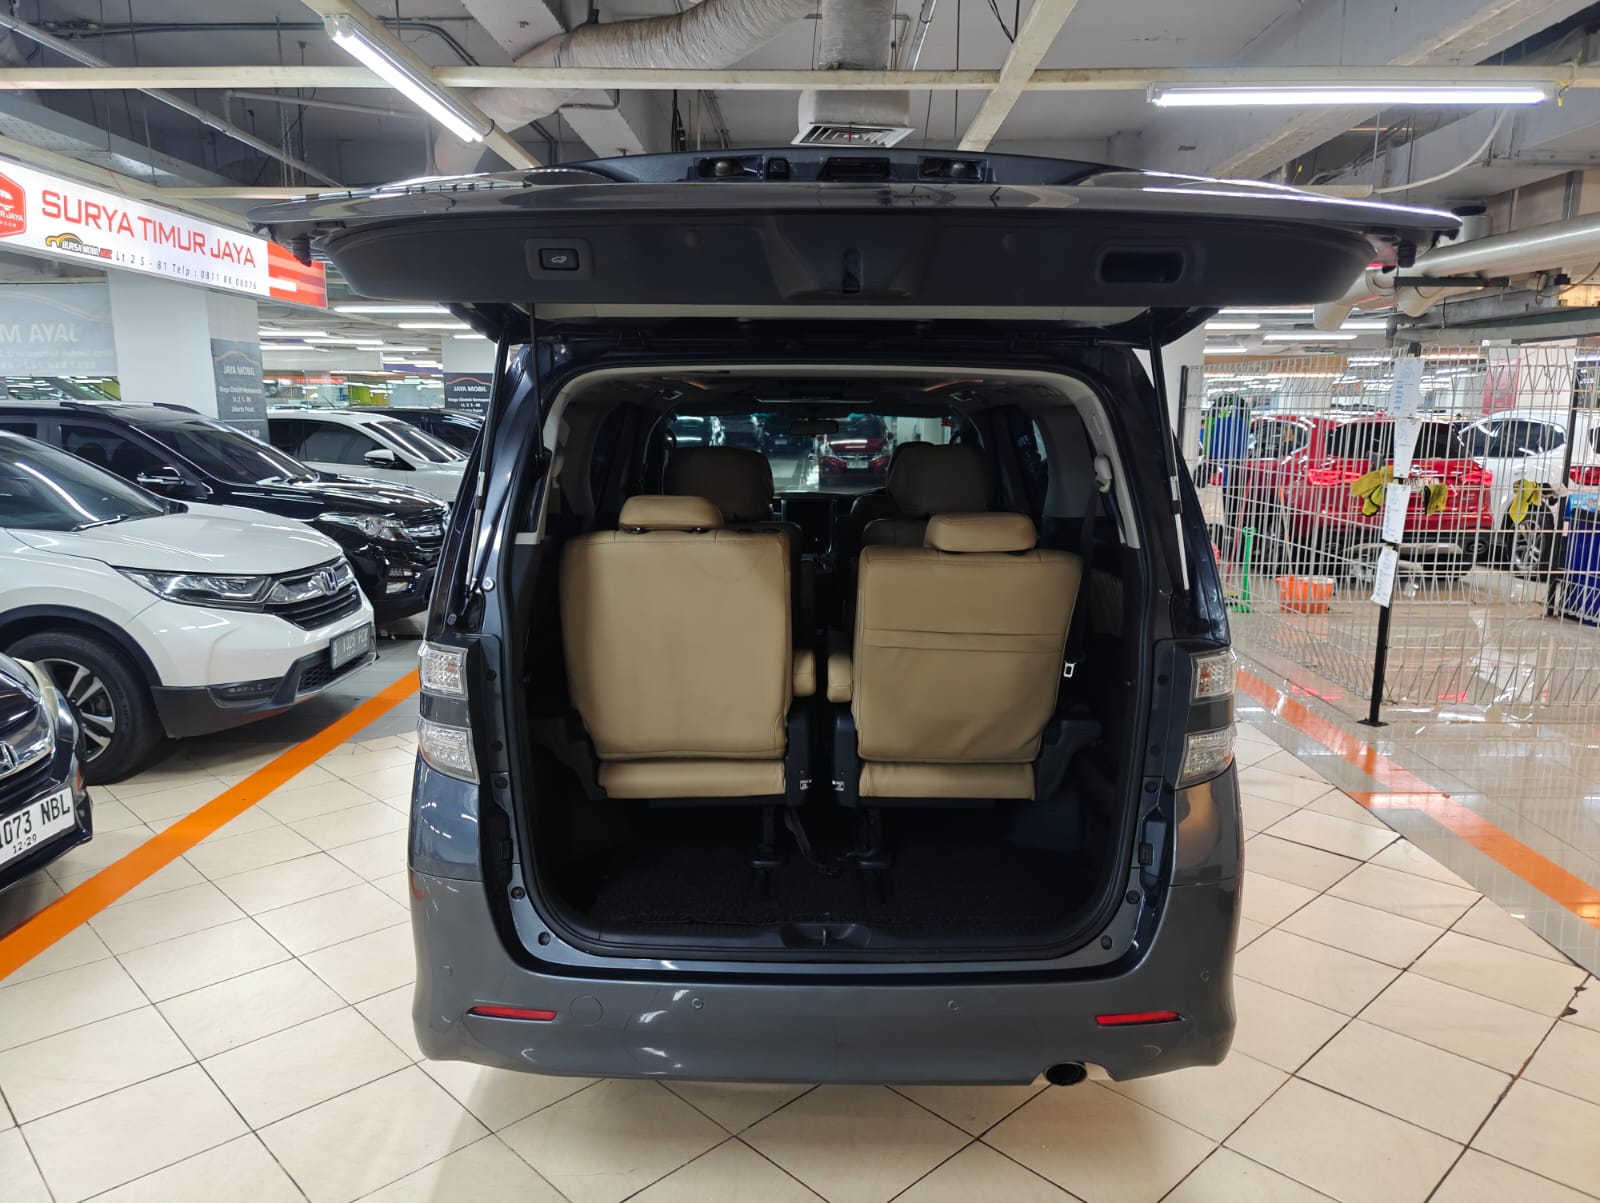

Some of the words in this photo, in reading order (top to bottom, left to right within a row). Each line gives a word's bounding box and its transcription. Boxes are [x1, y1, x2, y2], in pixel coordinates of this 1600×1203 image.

[42, 190, 134, 238] SURYA
[137, 216, 206, 255] TIMUR
[211, 238, 256, 269] JAYA
[41, 794, 70, 825] NBL
